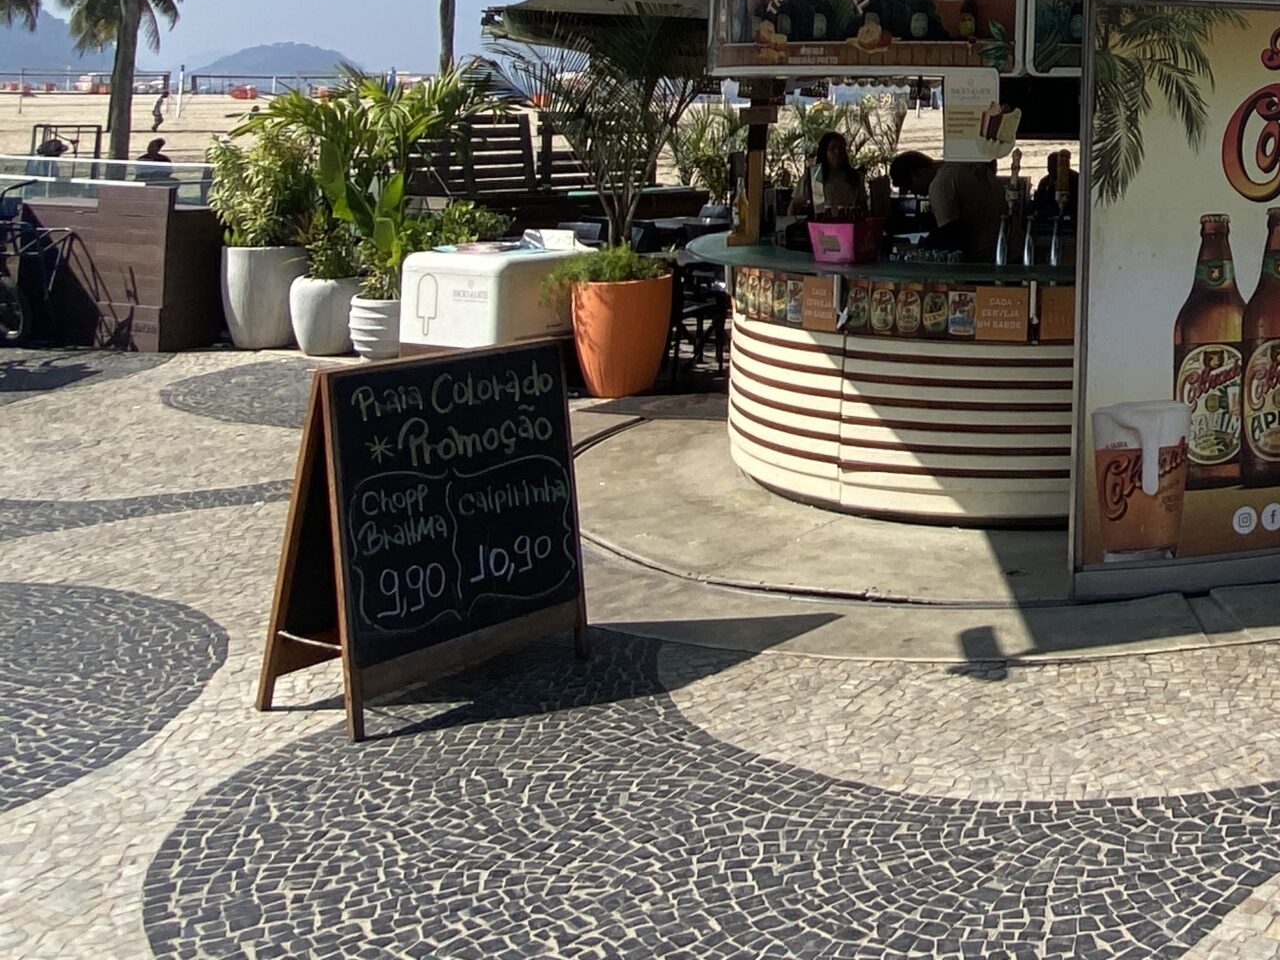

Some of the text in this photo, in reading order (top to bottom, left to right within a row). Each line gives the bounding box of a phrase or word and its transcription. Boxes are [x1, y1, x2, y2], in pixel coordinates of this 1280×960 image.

[981, 309, 1020, 318] CERVEJA
[351, 360, 554, 421] Praia Colorado
[398, 404, 553, 467] Promoção
[470, 535, 551, 583] 10,90
[377, 563, 446, 619] 9,90
